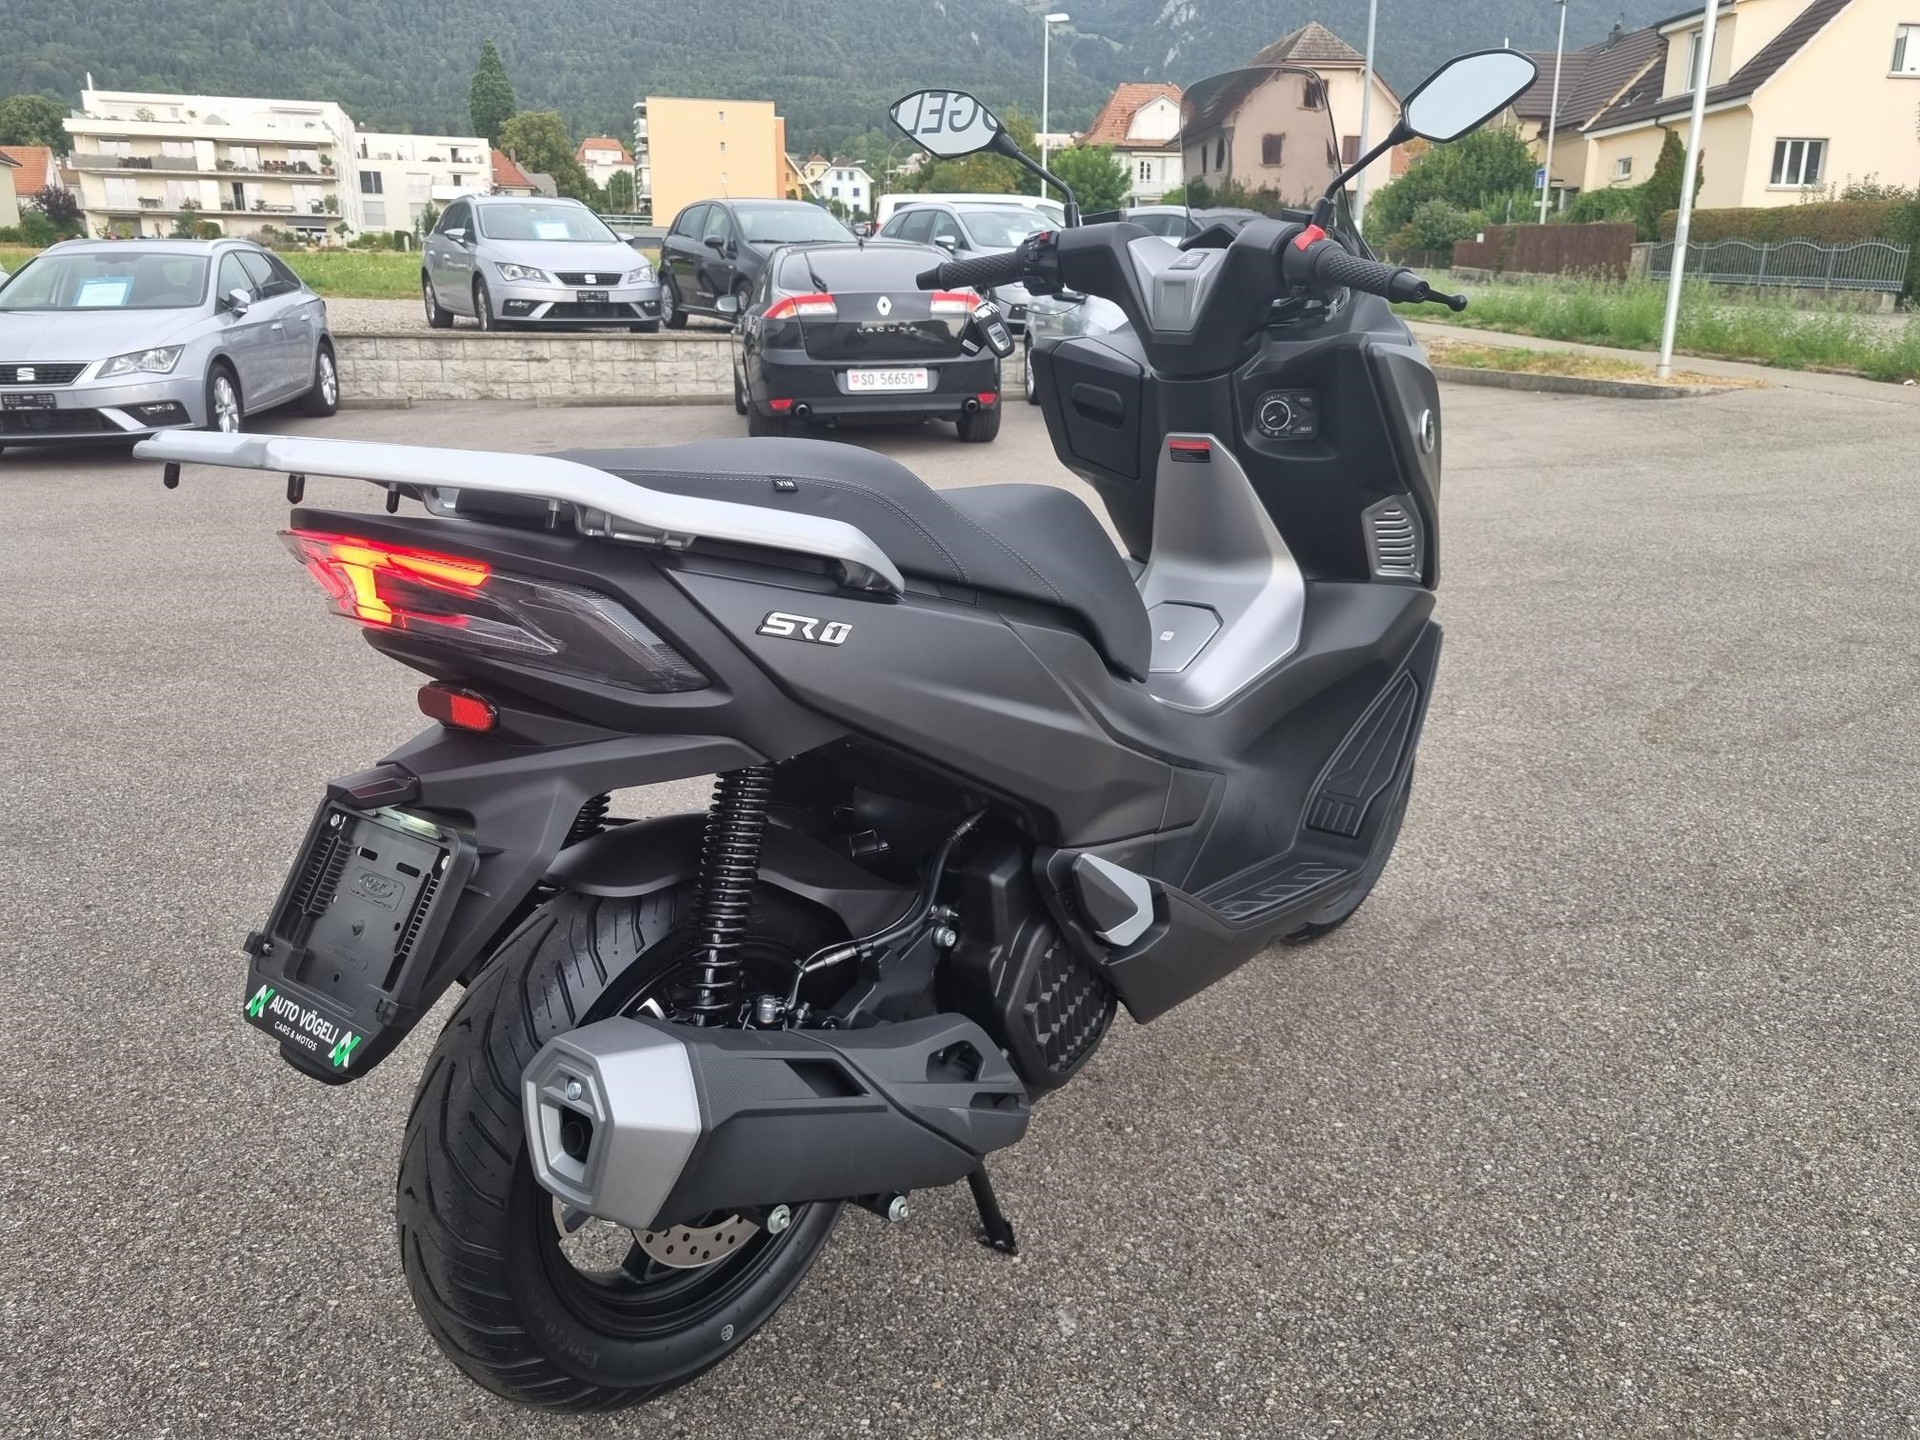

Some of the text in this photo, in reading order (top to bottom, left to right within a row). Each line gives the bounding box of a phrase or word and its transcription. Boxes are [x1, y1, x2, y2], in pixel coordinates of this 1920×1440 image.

[269, 995, 340, 1045] AUTO VÖGELI
[274, 1020, 318, 1052] CARS & MOTOS
